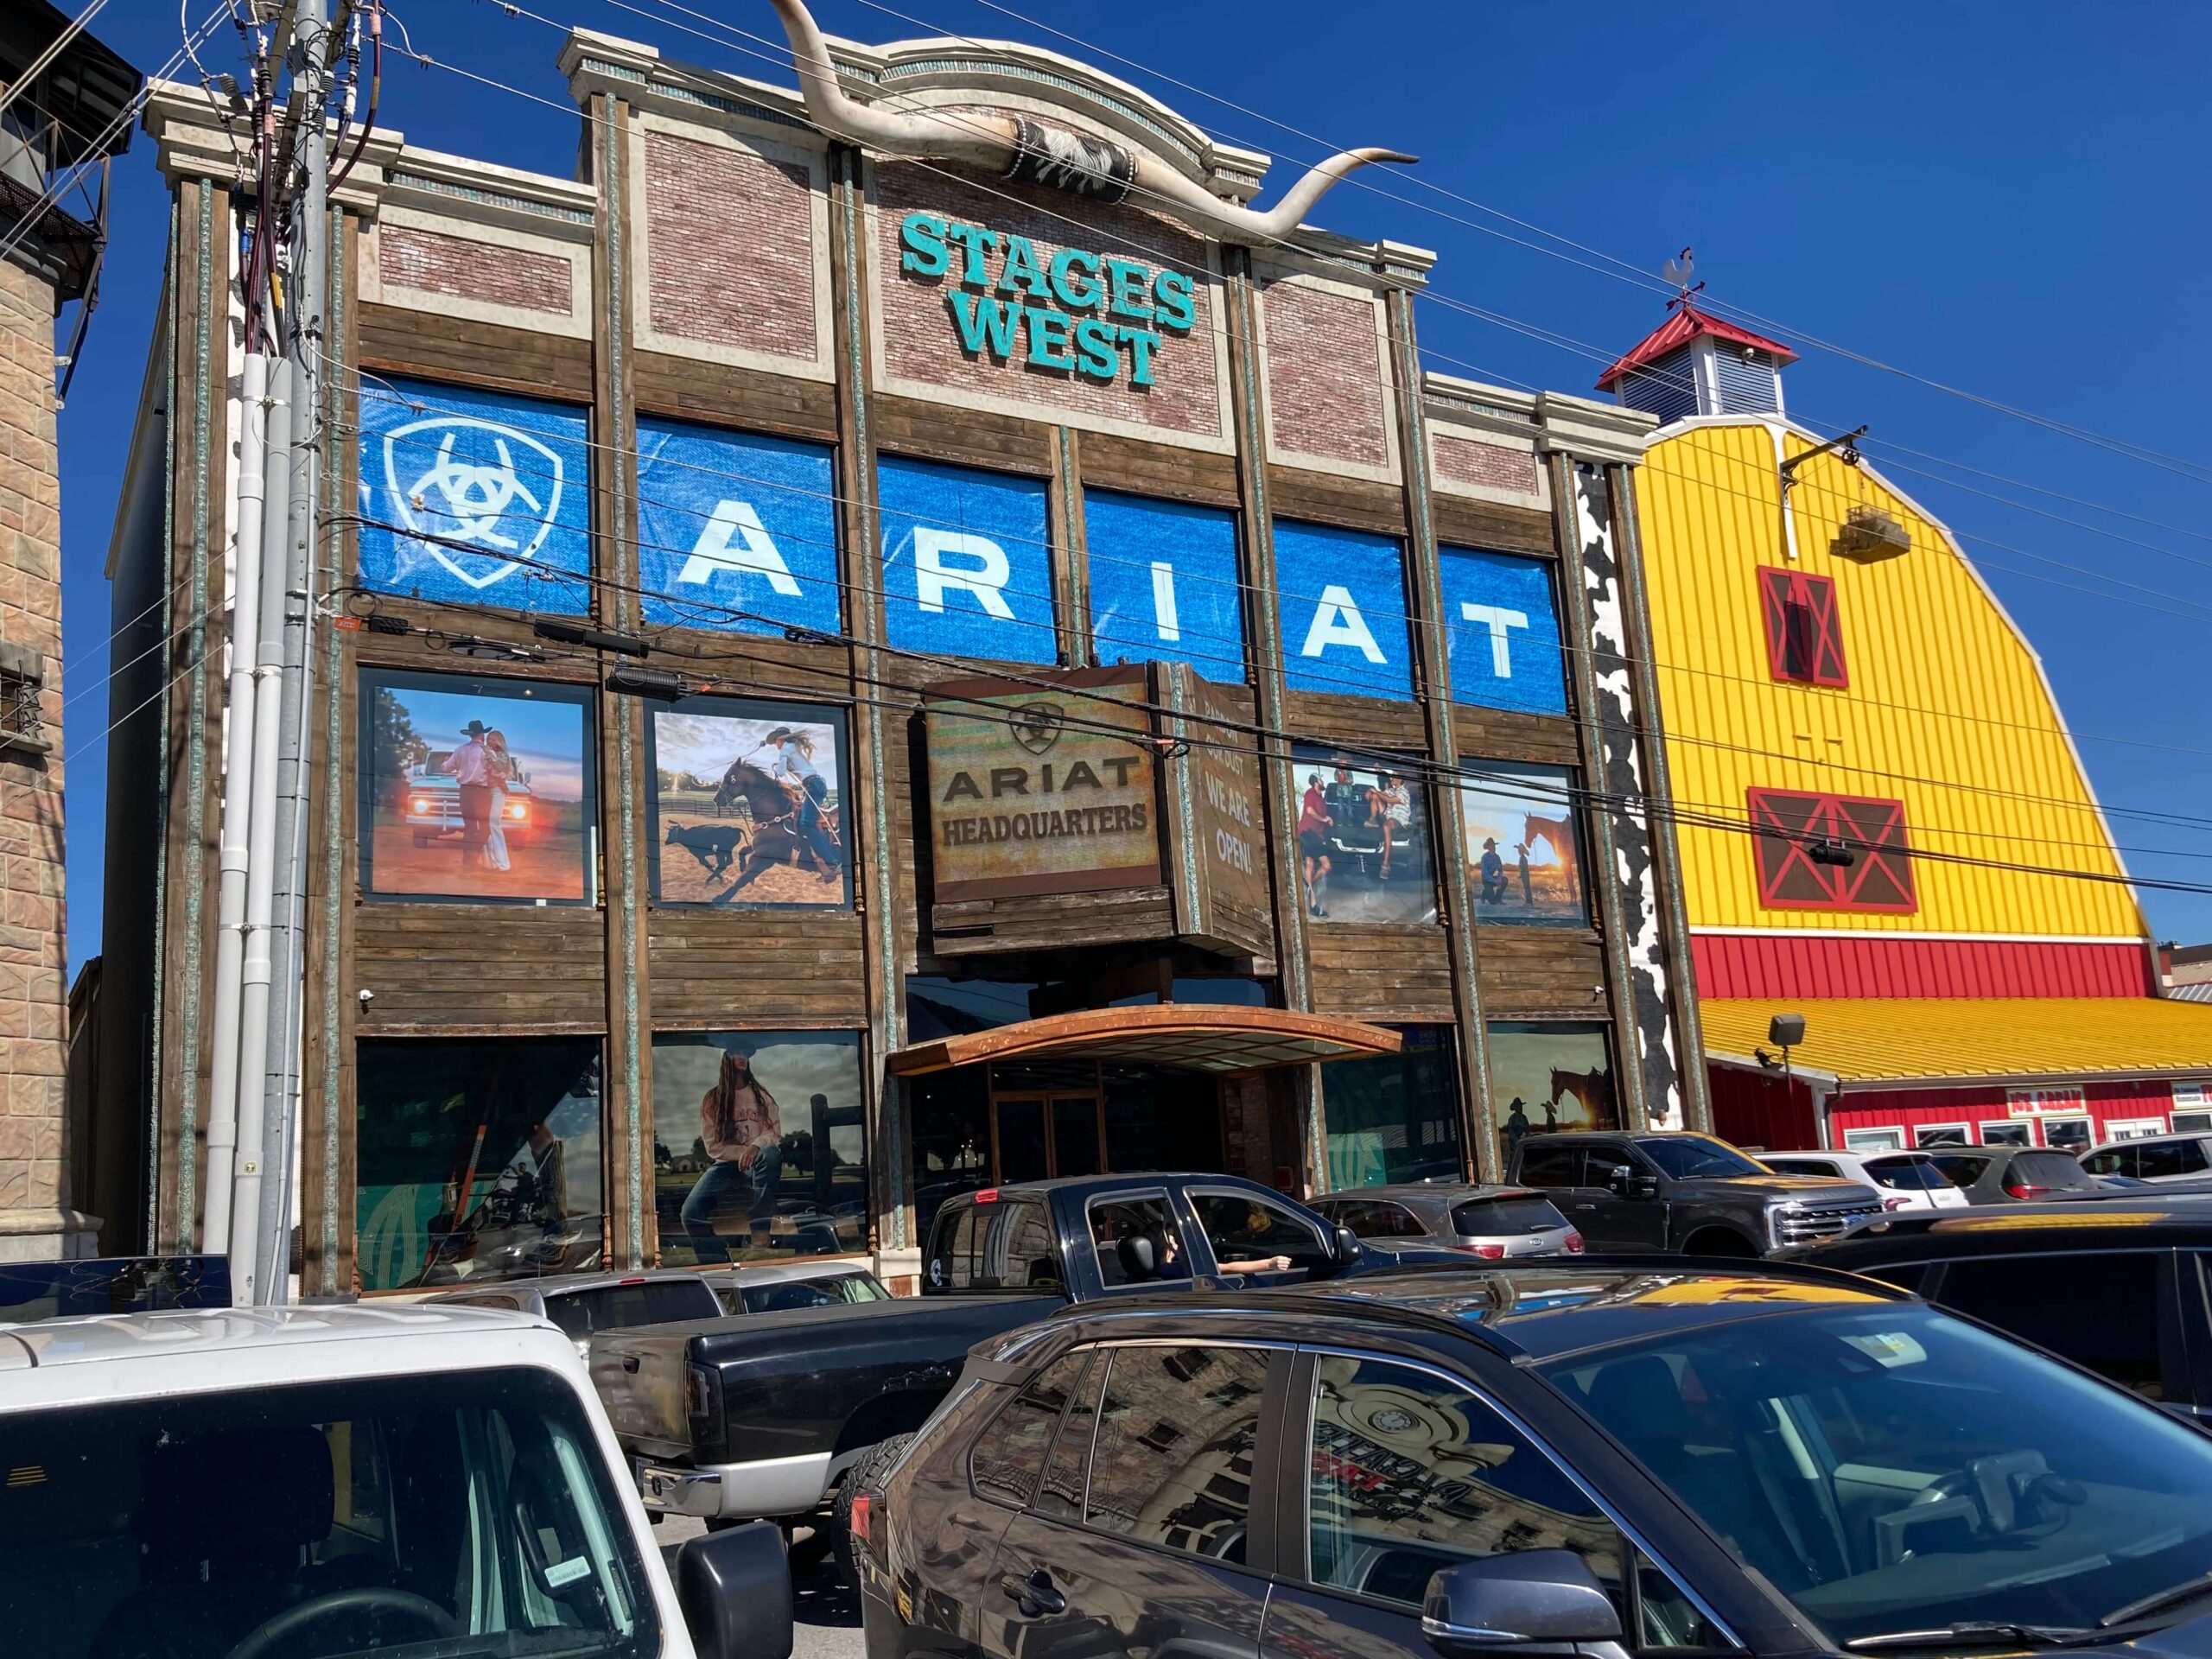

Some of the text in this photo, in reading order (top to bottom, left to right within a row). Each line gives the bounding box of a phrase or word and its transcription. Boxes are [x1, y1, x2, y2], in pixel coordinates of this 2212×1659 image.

[902, 213, 1198, 332] STAGES
[947, 290, 1161, 386] WEST
[677, 499, 1529, 678] ARIAT
[943, 756, 1141, 803] ARIAT
[1224, 747, 1244, 778] DUST
[1205, 771, 1251, 827] WE ARE
[942, 802, 1148, 847] HEADQUARTERS
[1216, 827, 1252, 875] OPEN!
[2009, 1091, 2034, 1113] ICE
